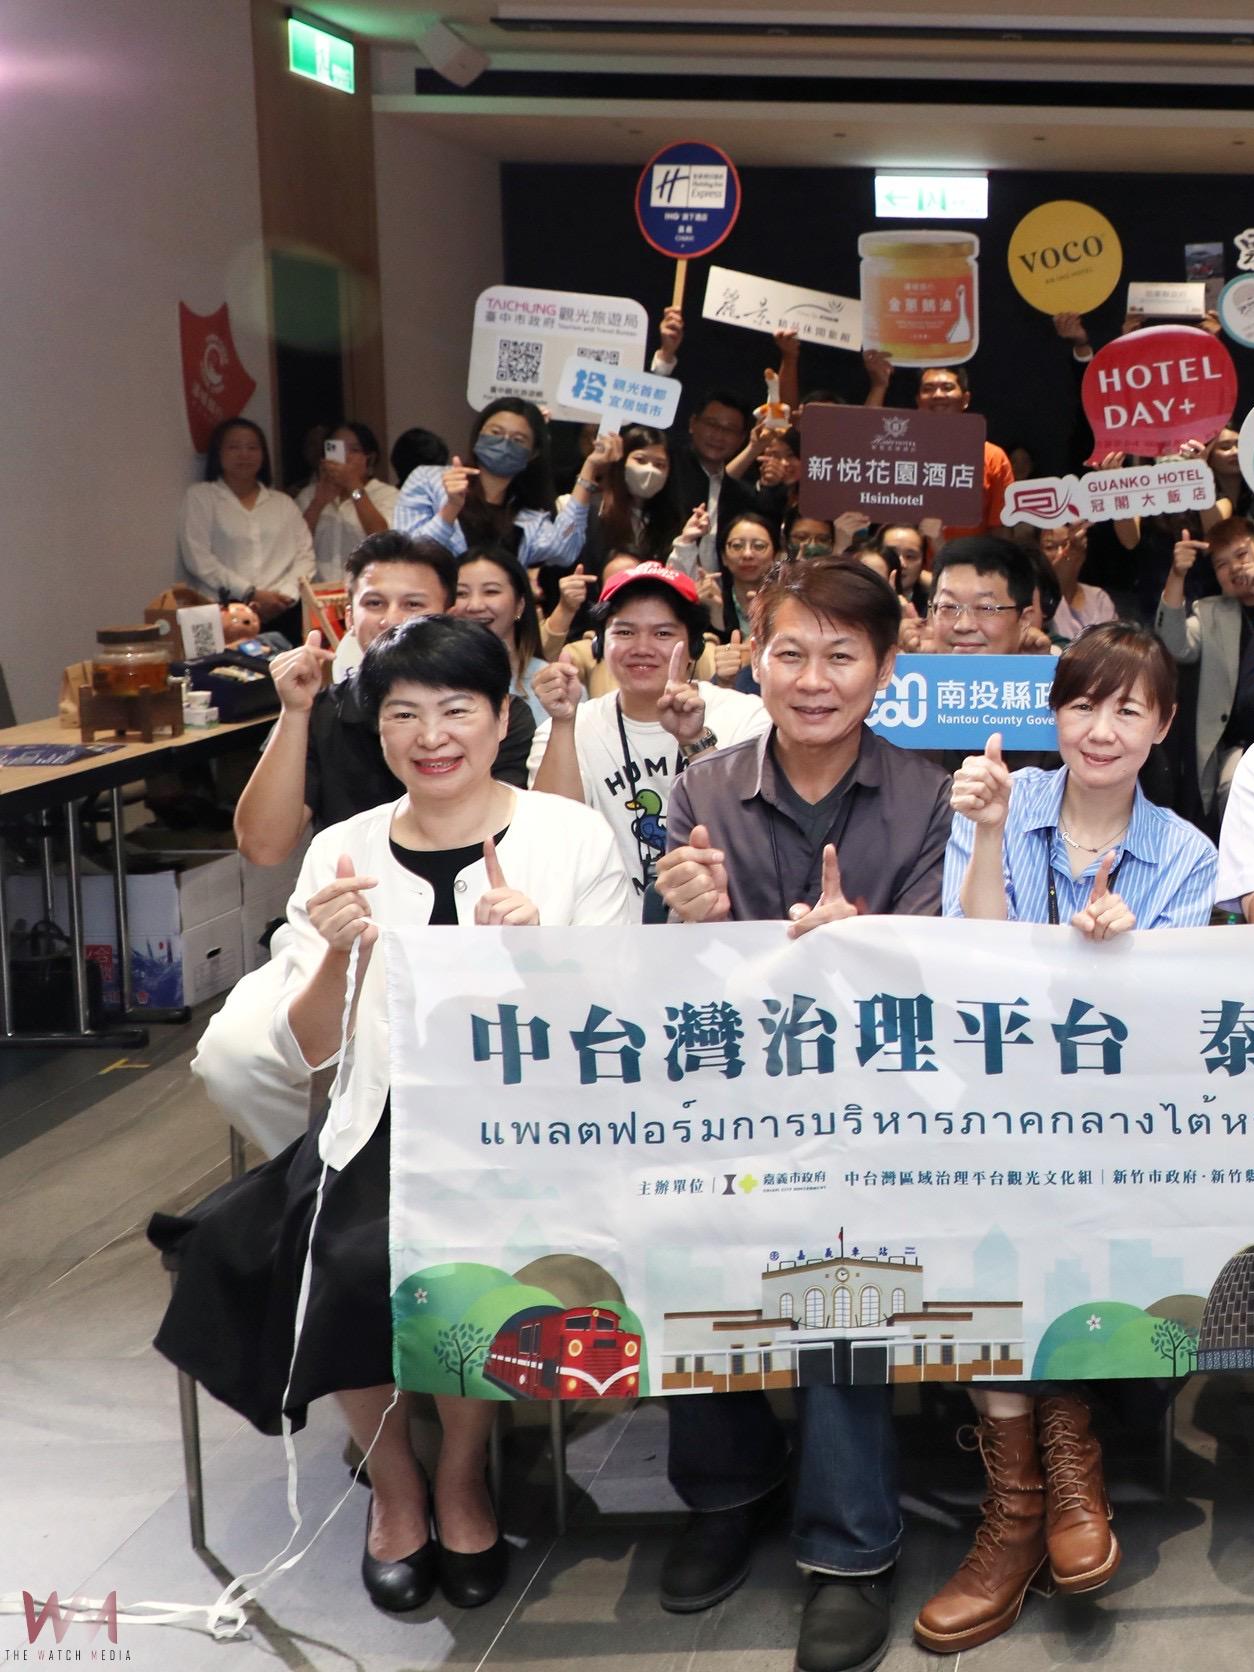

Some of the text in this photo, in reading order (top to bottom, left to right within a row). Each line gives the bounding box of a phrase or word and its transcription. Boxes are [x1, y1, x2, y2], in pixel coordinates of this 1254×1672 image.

[1018, 235, 1104, 274] VOCO
[486, 298, 558, 317] TAICHUNG
[558, 306, 639, 330] 觀光旅遊局
[1098, 356, 1223, 394] HOTEL
[611, 377, 668, 402] 觀光首都
[608, 394, 664, 418] 宜居城市
[1103, 397, 1196, 430] DAY+
[1087, 468, 1204, 493] GUANKO HOTEL
[860, 491, 924, 507] Hsinhotel
[937, 713, 979, 725] Nantou
[982, 713, 1023, 727] County
[470, 990, 1129, 1086] 中台灣治理平台
[638, 1178, 704, 1197] 主辦單位
[762, 1170, 826, 1186] 嘉義市政府
[844, 1168, 1093, 1187] 中台灣區域治理平台觀光文化組
